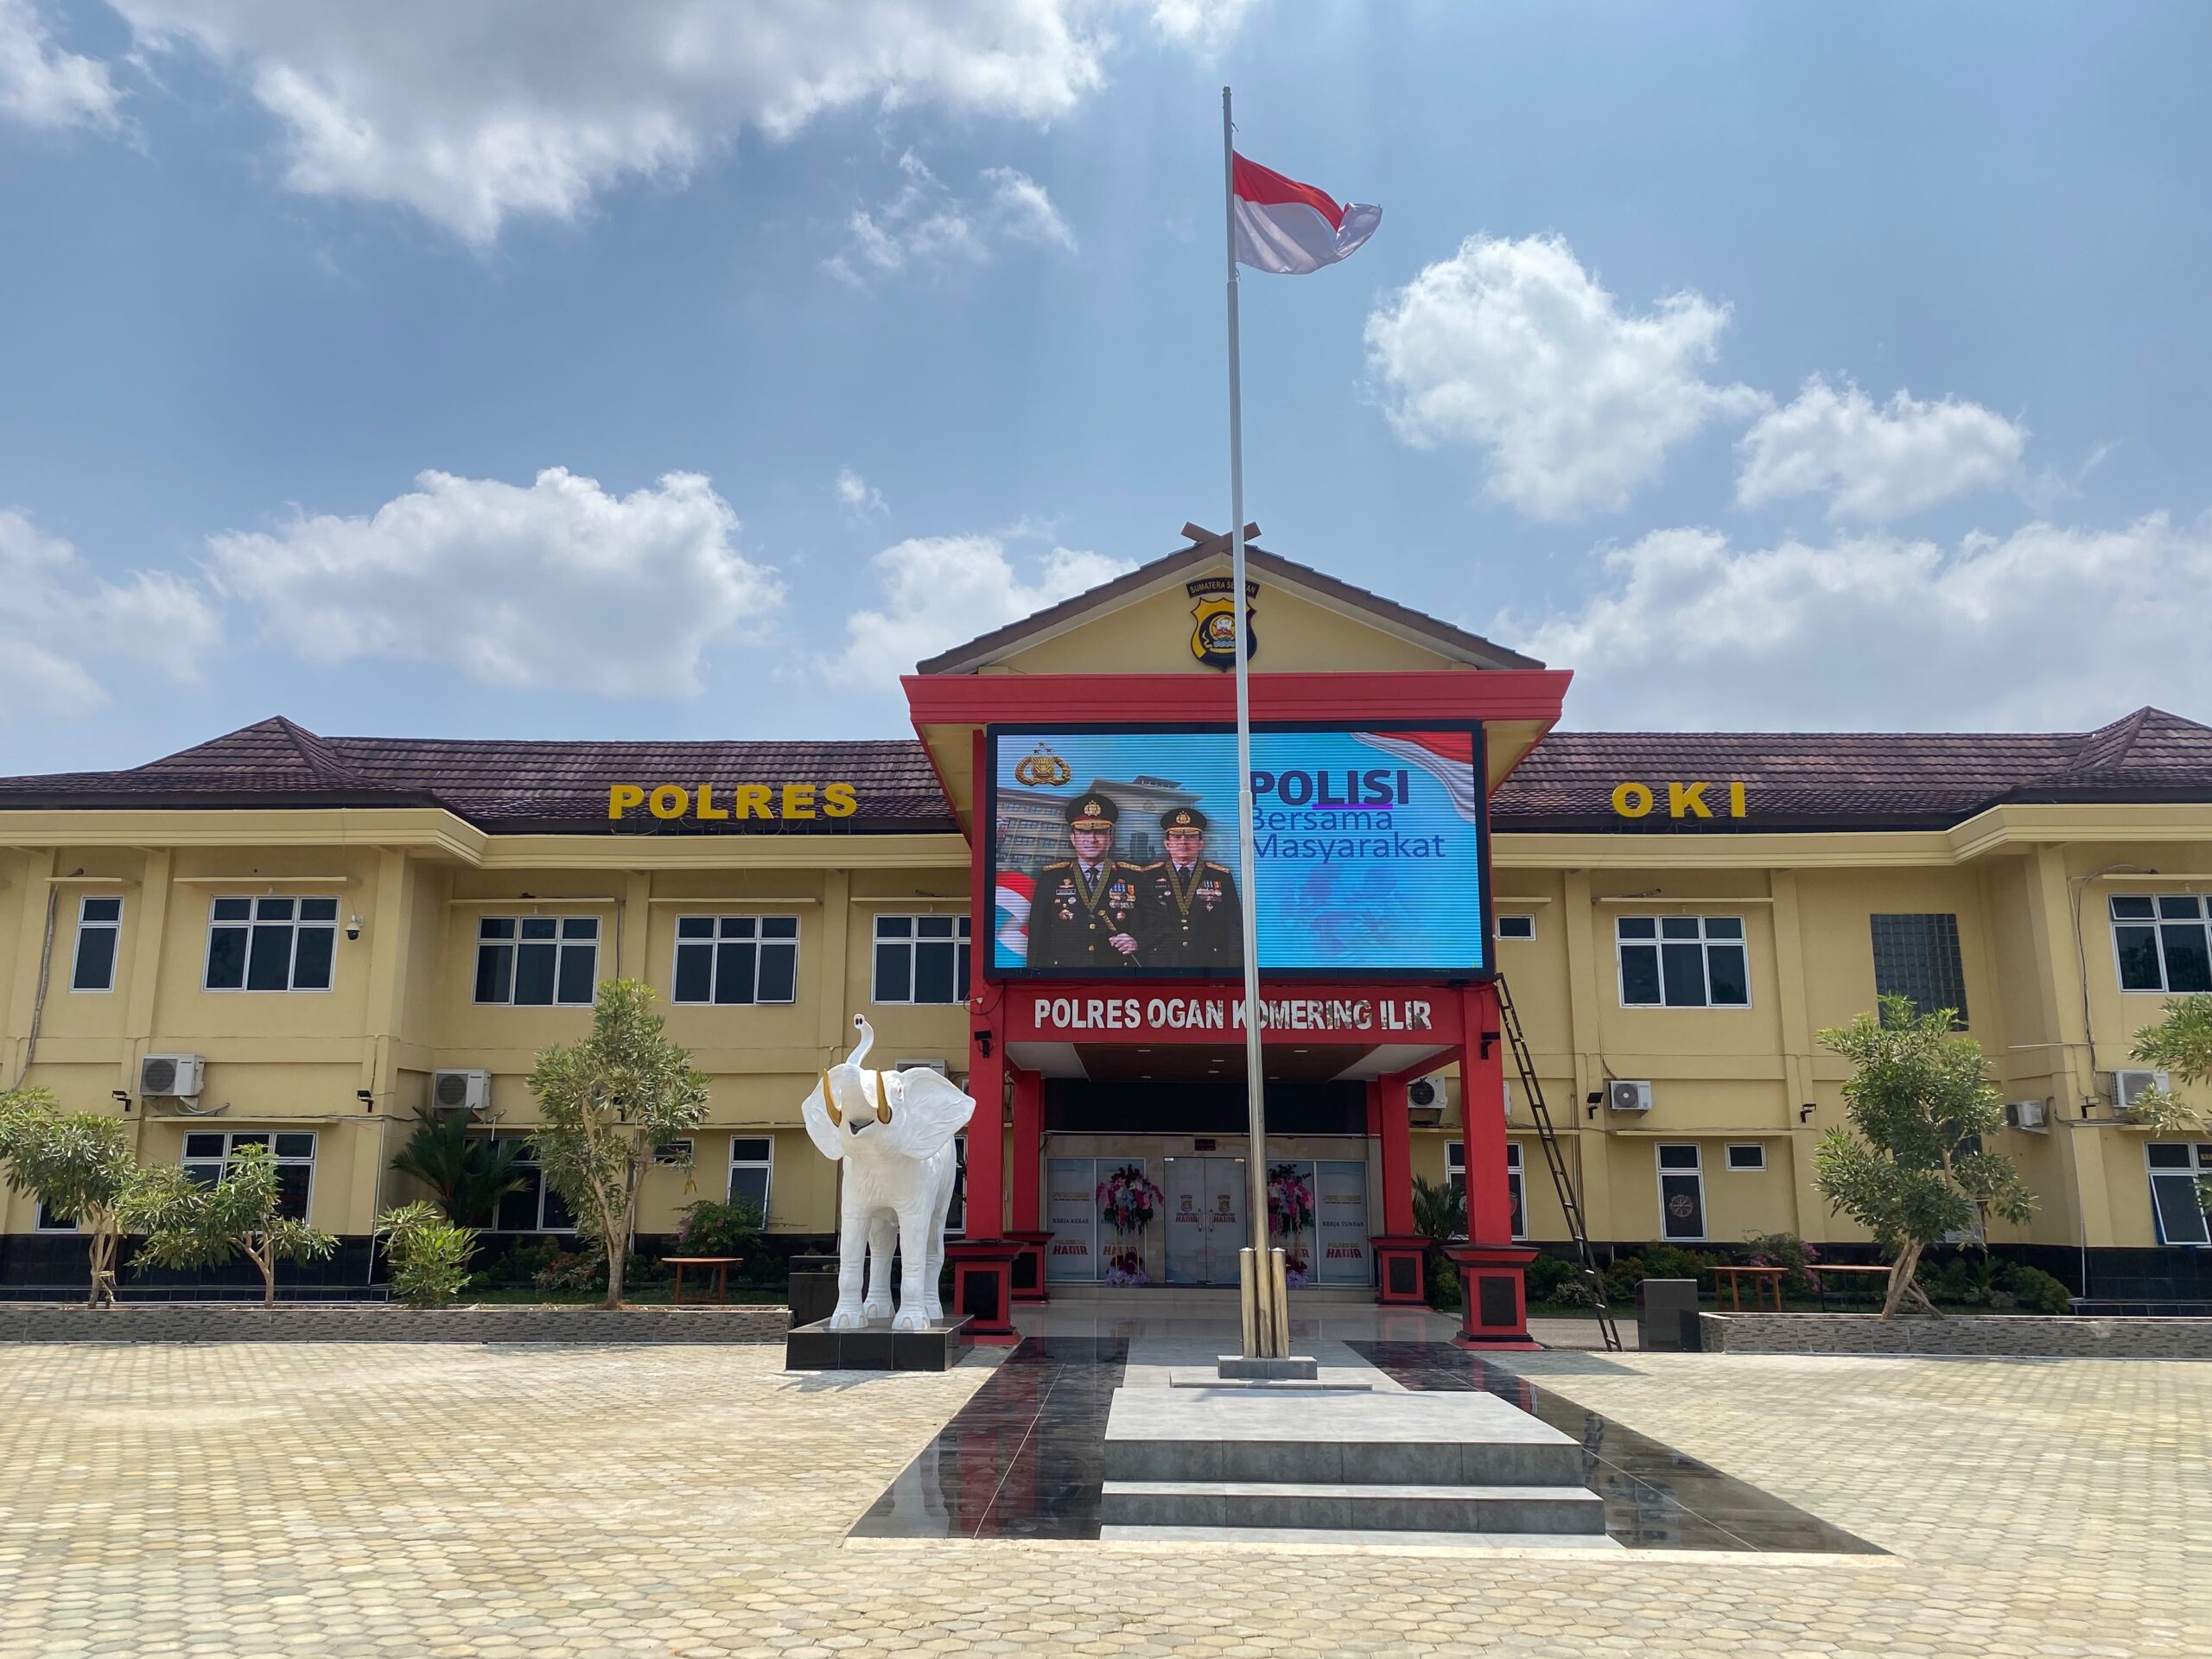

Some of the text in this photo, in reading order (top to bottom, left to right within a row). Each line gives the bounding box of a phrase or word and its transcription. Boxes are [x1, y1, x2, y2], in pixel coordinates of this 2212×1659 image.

[1190, 581, 1225, 594] SUMATERA
[607, 783, 858, 819] POLRES
[1250, 769, 1409, 805] POLISI
[1611, 782, 1747, 817] OKI
[1252, 806, 1393, 830] Bersama
[1253, 831, 1446, 864] Masyarakat
[1034, 998, 1141, 1028] POLRES
[1147, 998, 1224, 1029] OGAN
[1380, 1000, 1433, 1030] ILIR
